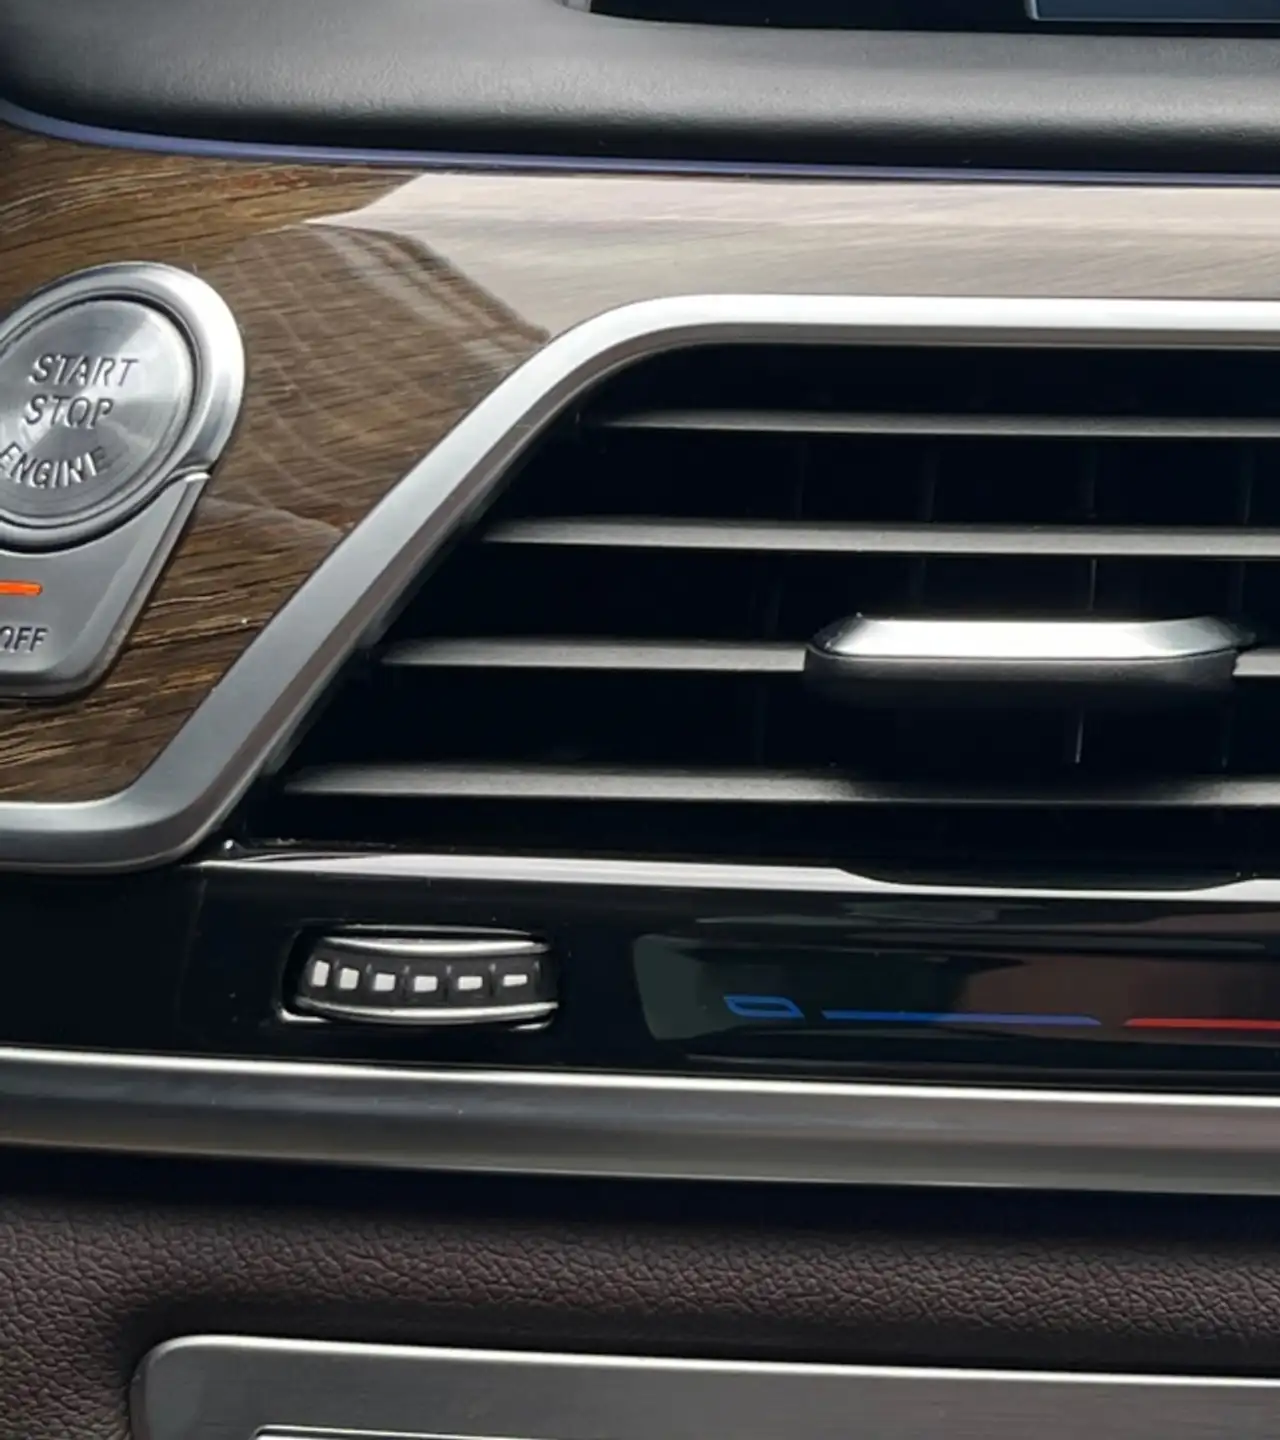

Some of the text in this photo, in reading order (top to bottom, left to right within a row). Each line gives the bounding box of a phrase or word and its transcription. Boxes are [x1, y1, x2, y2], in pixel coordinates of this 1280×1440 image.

[28, 352, 139, 386] START
[23, 393, 114, 428] STOP
[0, 440, 107, 489] ENGINE
